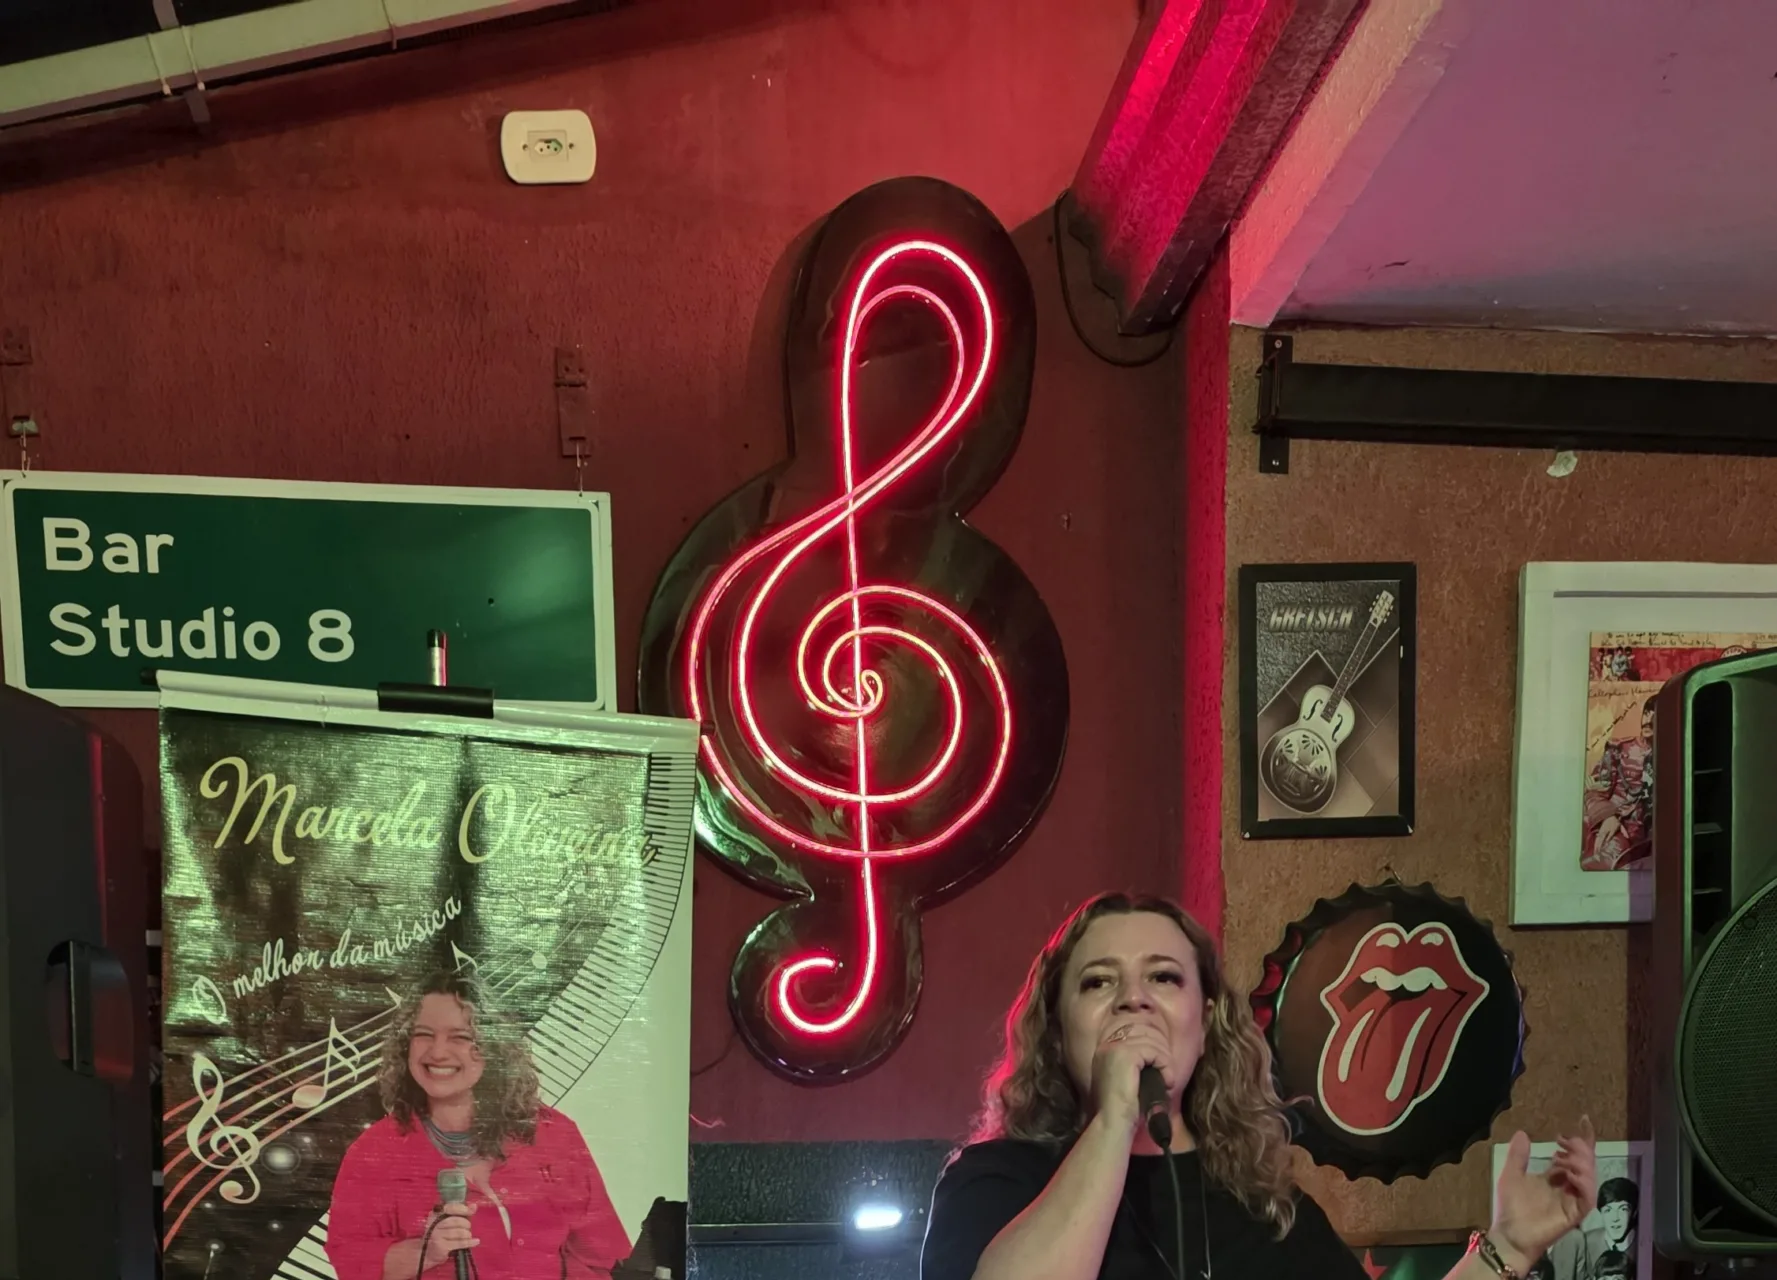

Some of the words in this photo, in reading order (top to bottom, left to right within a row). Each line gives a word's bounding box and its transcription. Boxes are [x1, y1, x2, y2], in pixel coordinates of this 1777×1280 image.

[43, 516, 175, 574] Bar
[49, 602, 282, 662] Studio
[307, 608, 356, 663] 8
[1268, 604, 1354, 631] GRETSCH
[199, 755, 443, 865] Marcela
[233, 938, 325, 999] melhor
[329, 928, 370, 969] da
[373, 896, 462, 960] música
